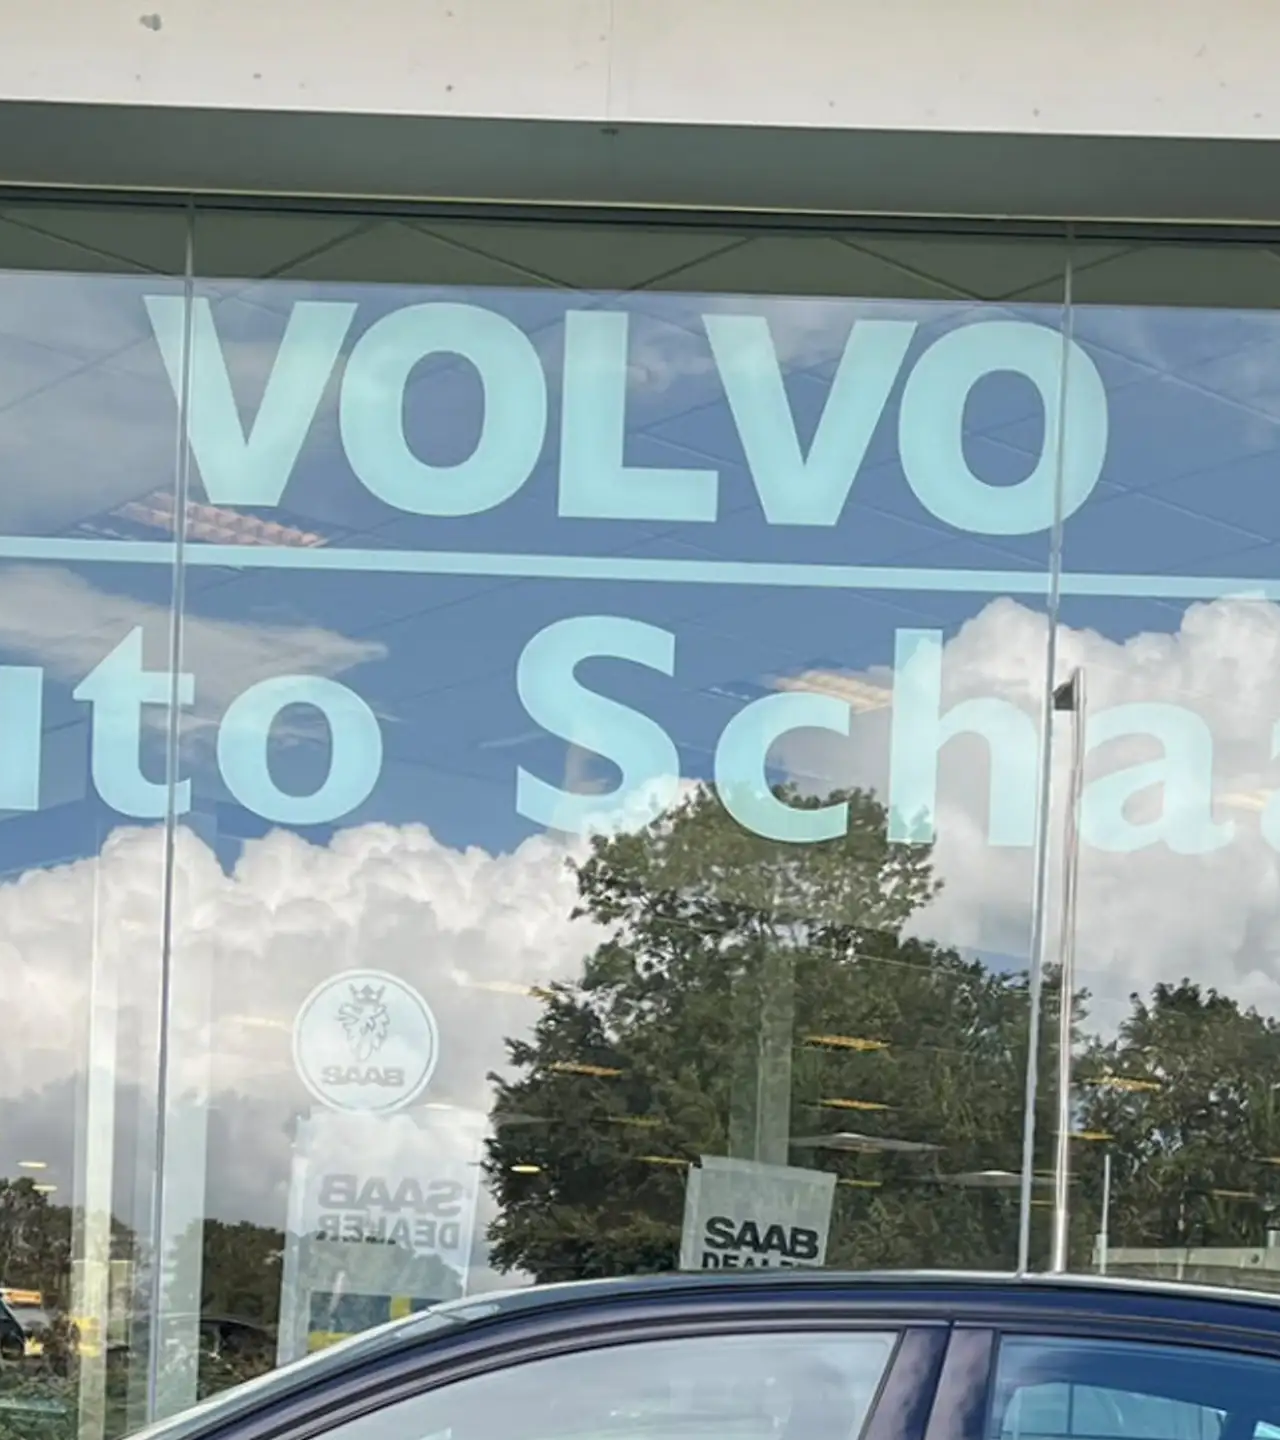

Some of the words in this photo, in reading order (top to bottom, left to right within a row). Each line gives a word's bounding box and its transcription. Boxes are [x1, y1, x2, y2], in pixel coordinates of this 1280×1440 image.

[143, 294, 1109, 535] VOLVO
[321, 1065, 406, 1088] SAAB
[704, 1216, 818, 1259] SAAB
